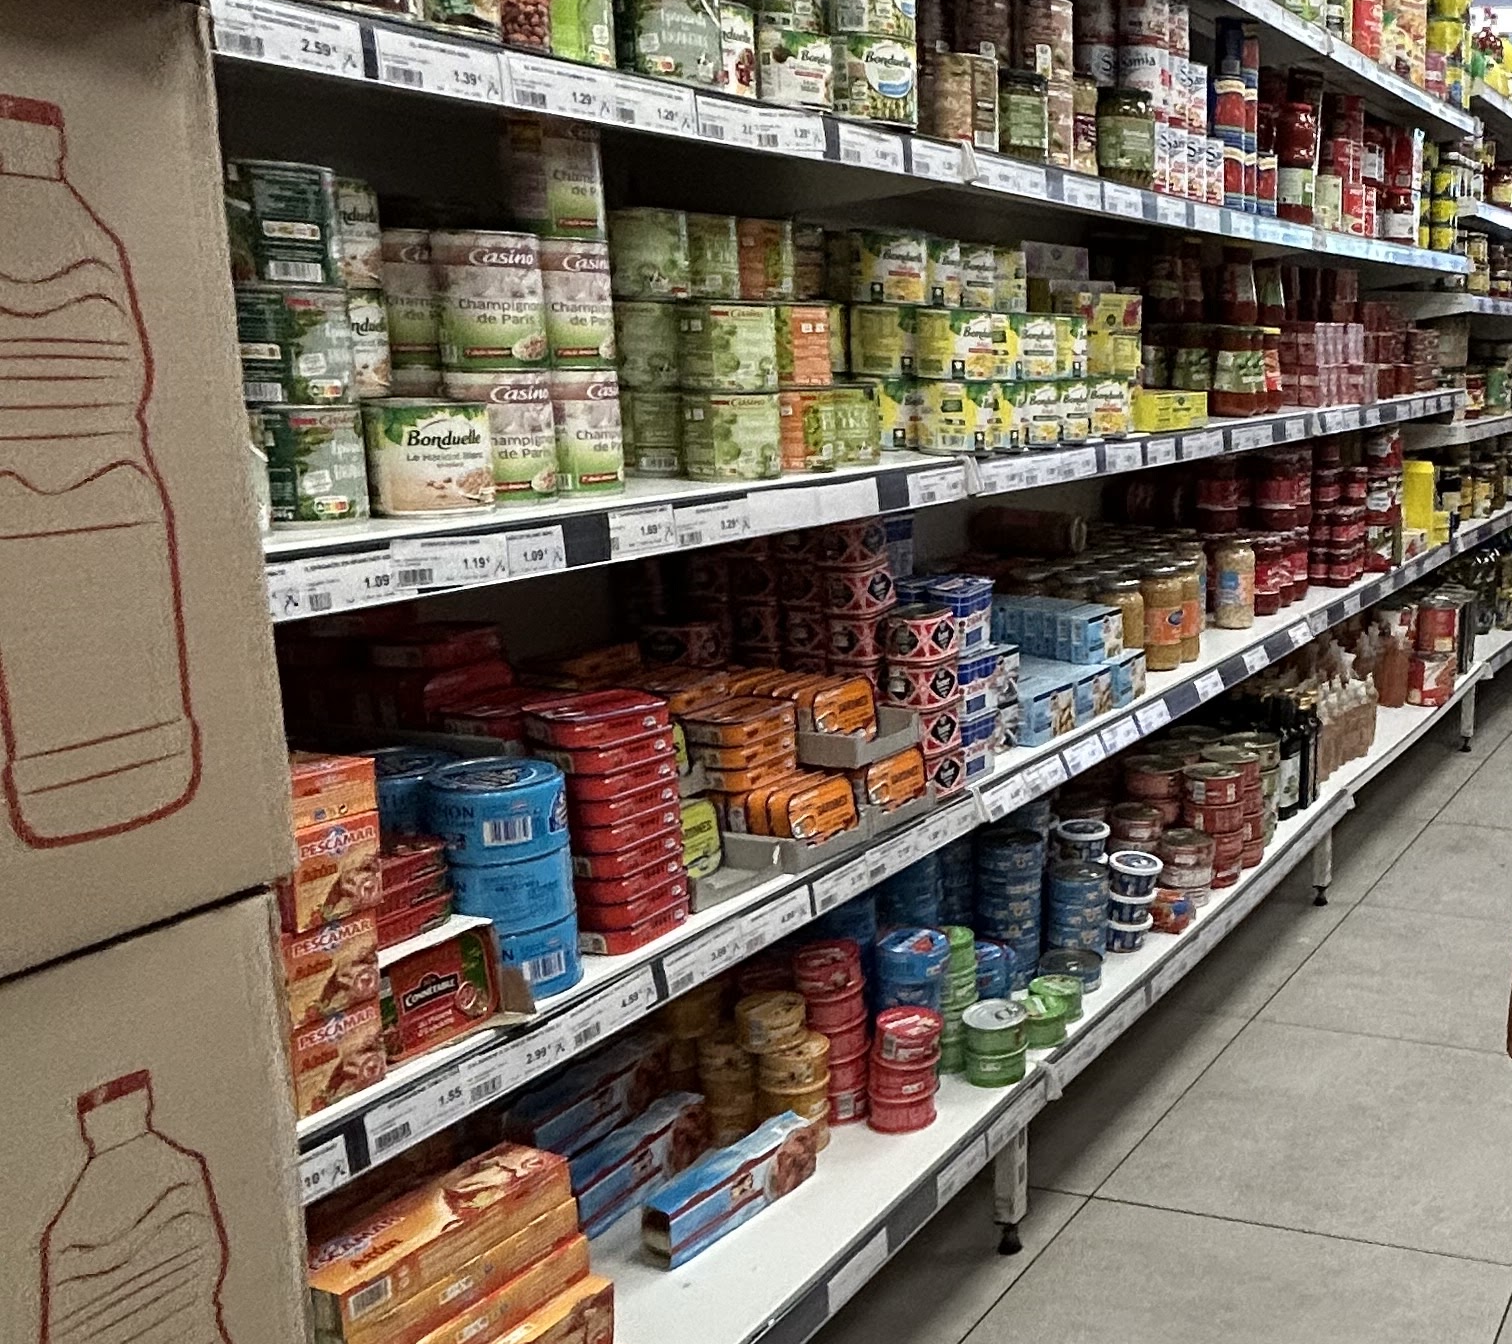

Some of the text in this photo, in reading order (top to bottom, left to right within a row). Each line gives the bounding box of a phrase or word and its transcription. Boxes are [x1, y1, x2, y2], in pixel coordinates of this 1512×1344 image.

[469, 247, 534, 267] Casino
[477, 313, 498, 325] de
[570, 315, 587, 327] de
[491, 385, 549, 403] Casino
[407, 429, 481, 450] Bonduelle
[301, 825, 375, 859] PESCAMAR
[292, 918, 374, 958] PESCAMAR
[298, 1004, 378, 1052] PESCAMAR
